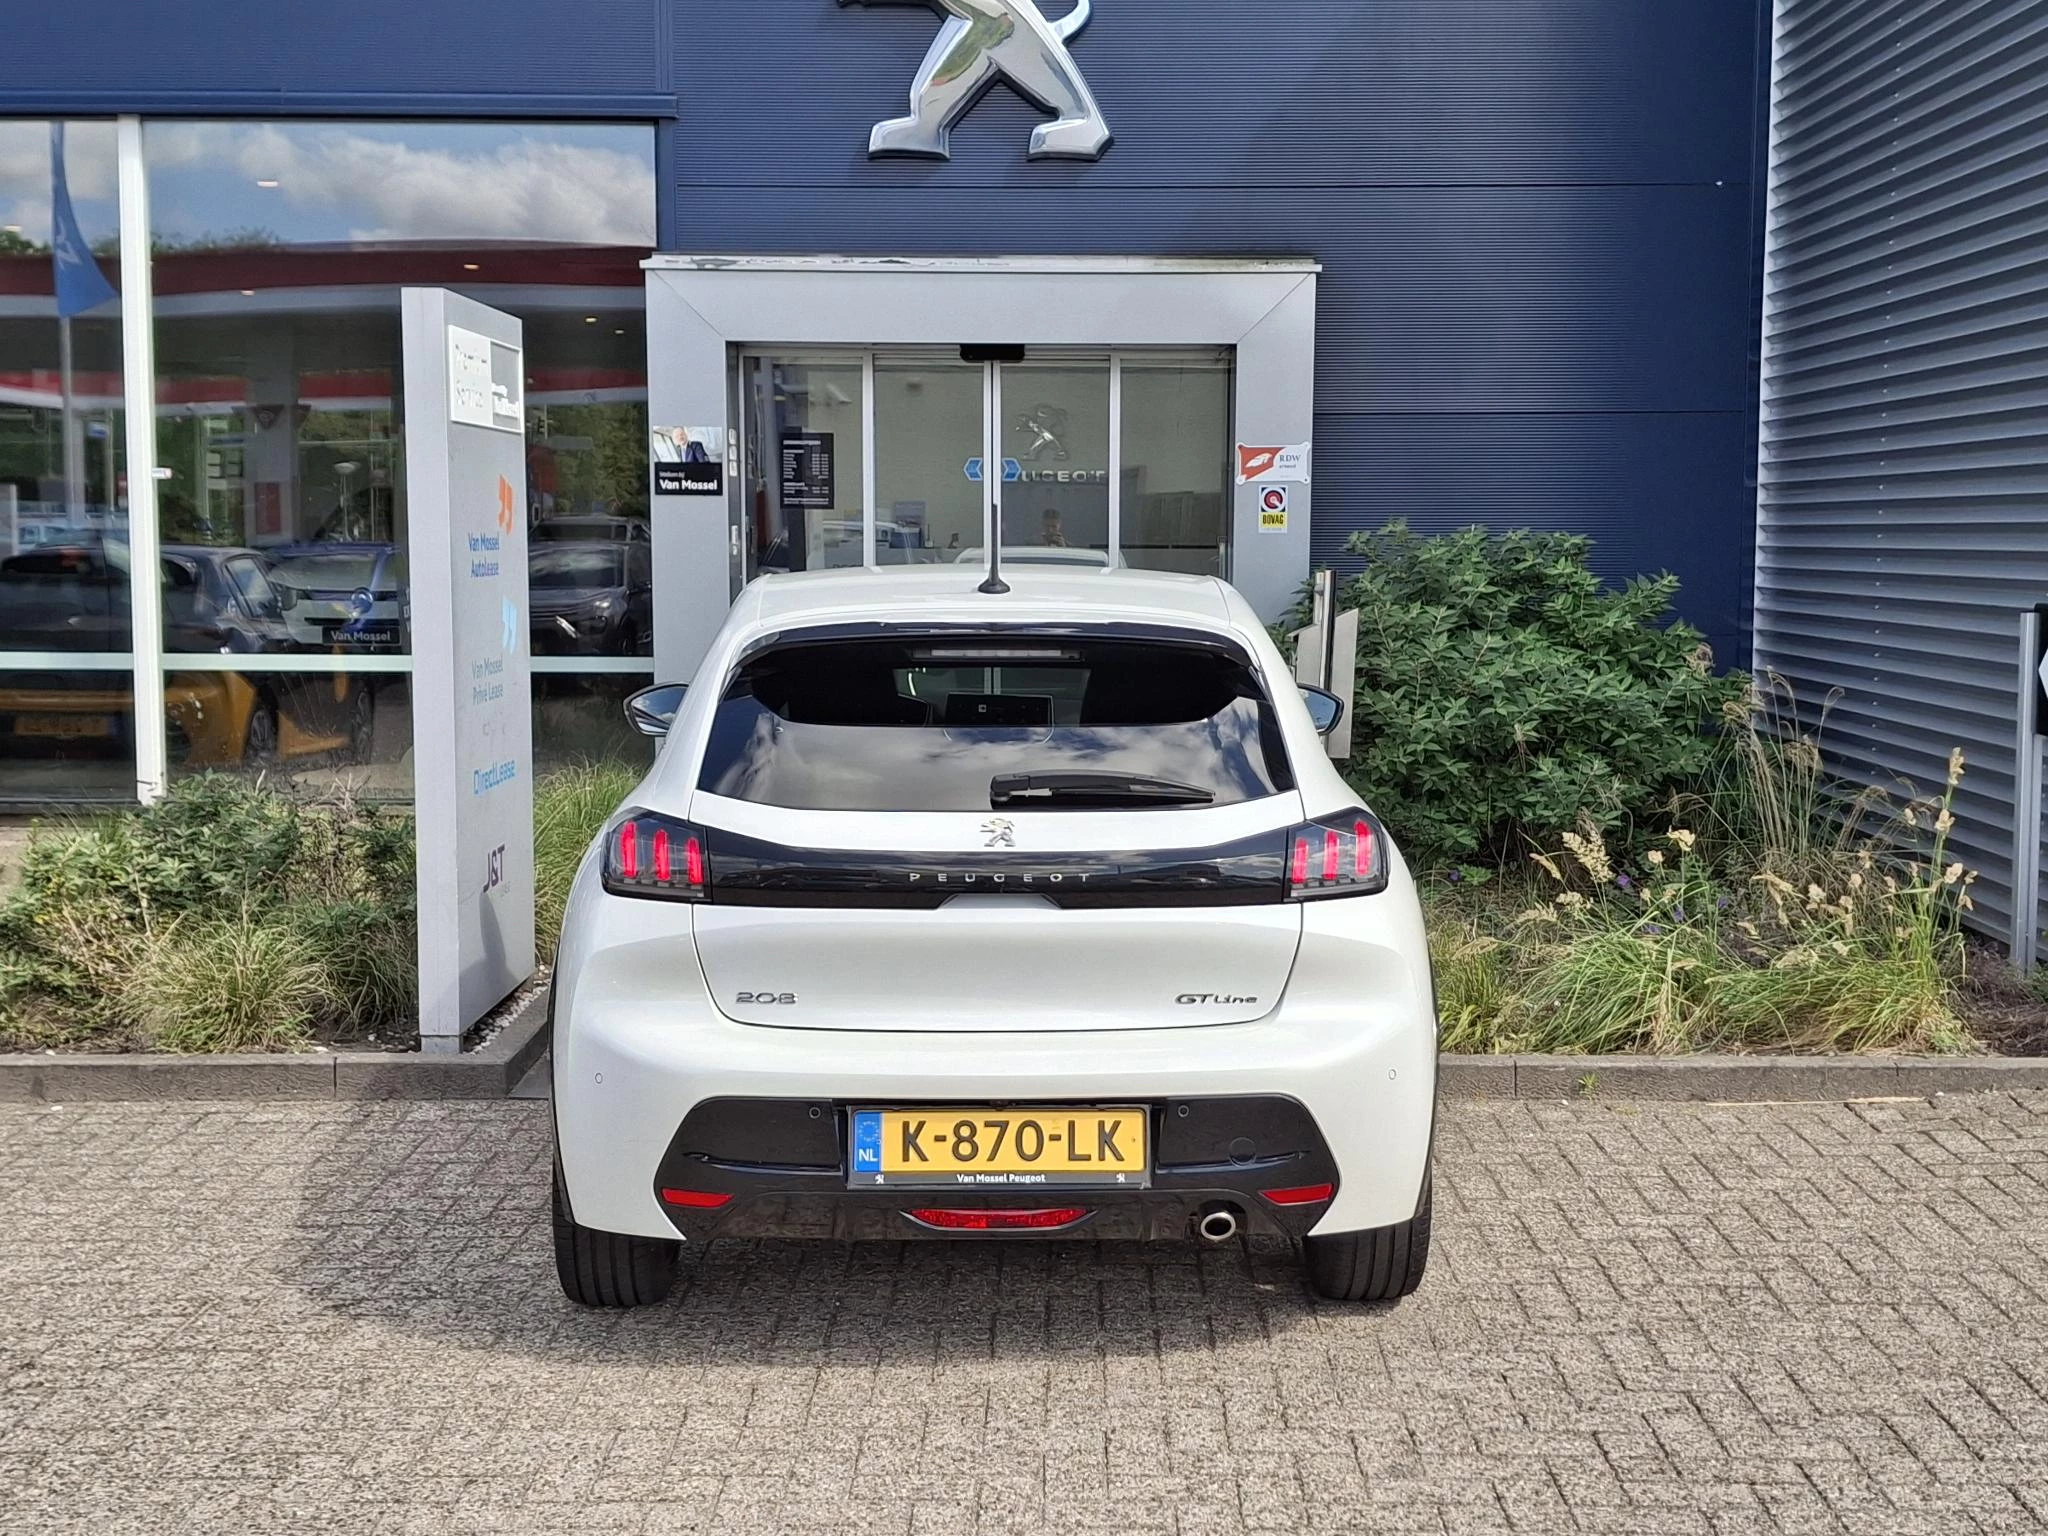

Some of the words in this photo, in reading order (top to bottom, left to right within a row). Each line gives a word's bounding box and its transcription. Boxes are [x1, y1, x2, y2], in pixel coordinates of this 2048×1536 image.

[1279, 454, 1301, 462] RDW
[659, 479, 680, 490] Van
[681, 479, 718, 490] Mossel
[1262, 514, 1284, 525] BOVAG
[468, 531, 480, 552] Van
[480, 531, 500, 551] Mossel
[470, 556, 499, 578] Autolease
[330, 630, 351, 641] Van
[353, 630, 391, 641] Mossel
[471, 658, 483, 680] Van
[483, 655, 504, 677] Mossel
[488, 682, 504, 700] Lease
[473, 759, 515, 795] DirectLease
[909, 872, 1091, 882] PEUGEOT
[735, 991, 797, 1004] 208
[901, 1119, 1126, 1163] K-870-LK
[858, 1147, 879, 1162] NL
[956, 1173, 975, 1183] Van
[976, 1173, 1007, 1183] Mossel
[1008, 1173, 1046, 1185] Peugeot
